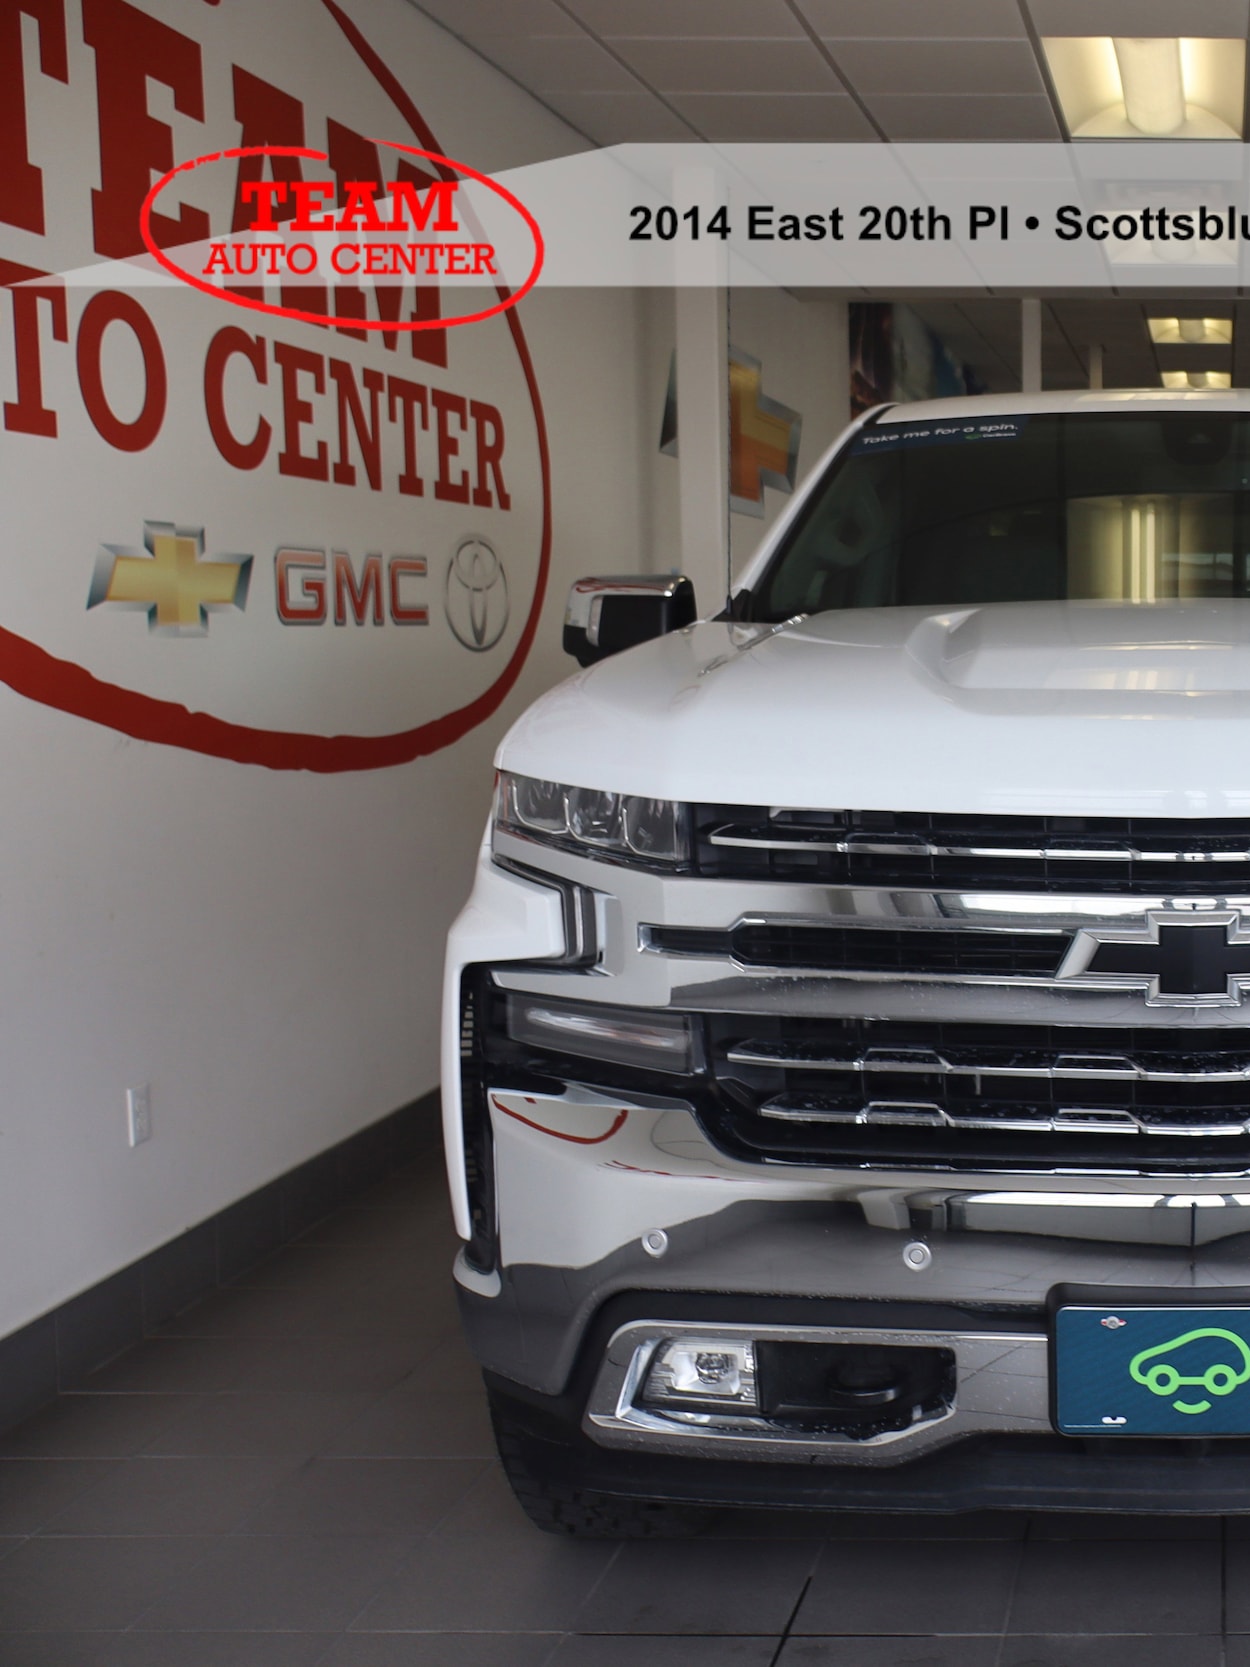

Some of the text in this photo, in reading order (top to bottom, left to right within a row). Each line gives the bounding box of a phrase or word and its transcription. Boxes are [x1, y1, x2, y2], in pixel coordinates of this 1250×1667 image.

[204, 325, 511, 511] CENTER
[862, 433, 900, 445] Take
[903, 430, 931, 439] me
[934, 427, 961, 436] for
[979, 423, 1019, 433] spin.
[274, 546, 430, 627] GMC
